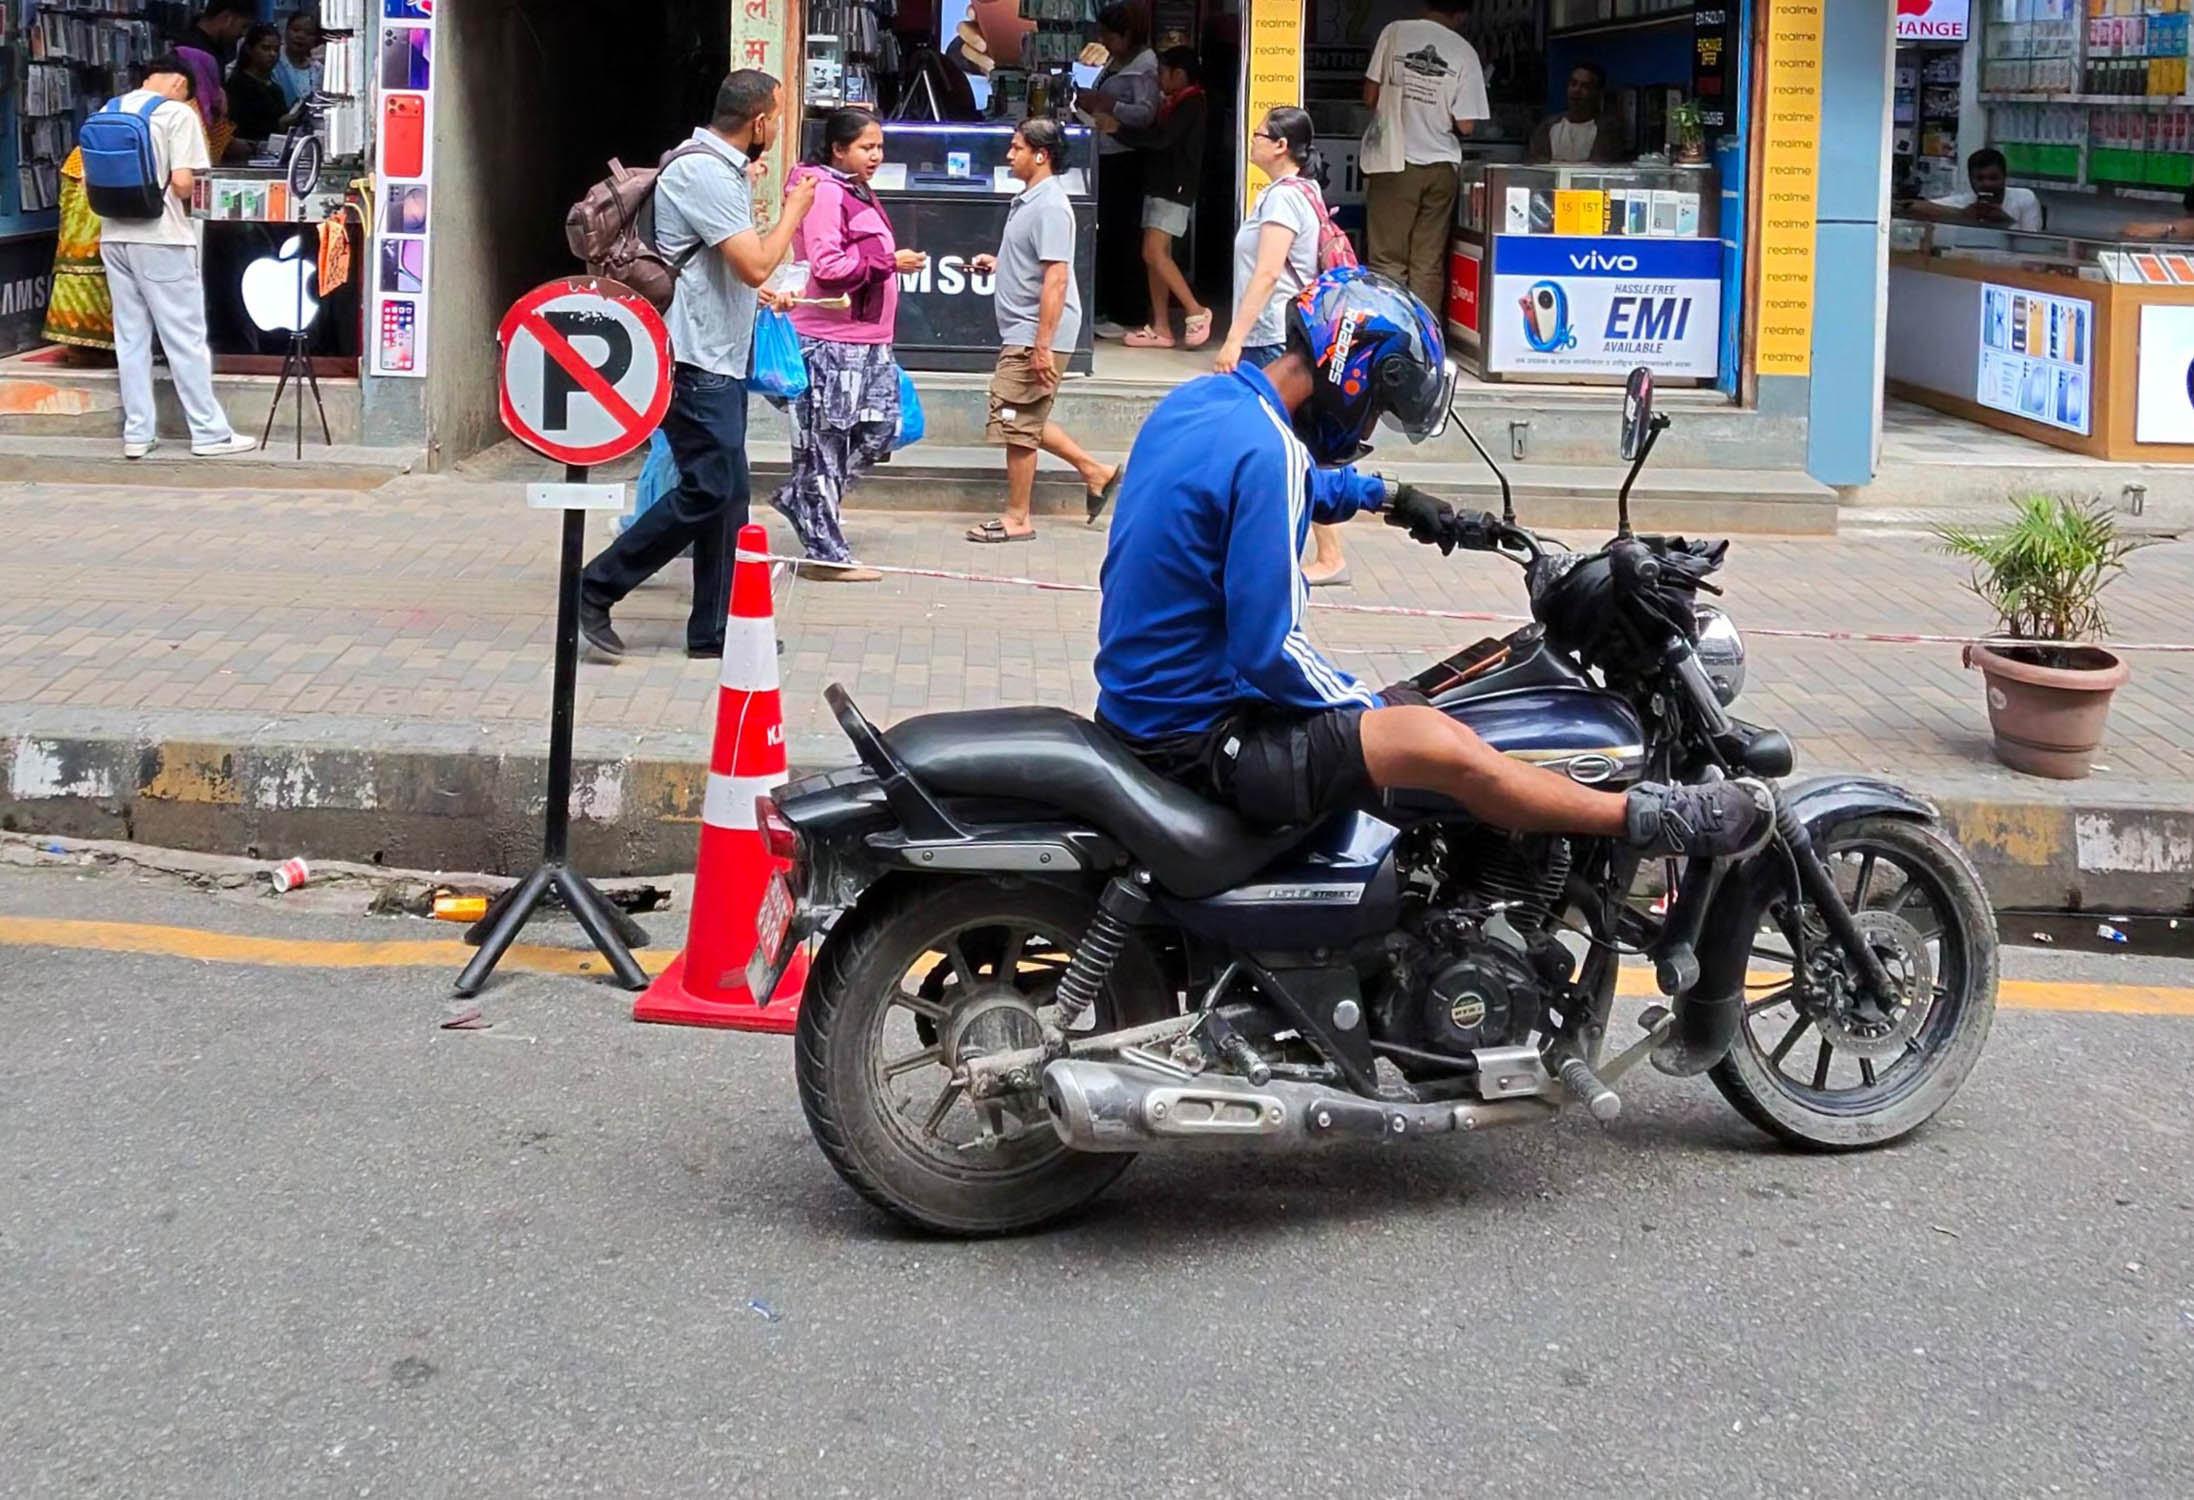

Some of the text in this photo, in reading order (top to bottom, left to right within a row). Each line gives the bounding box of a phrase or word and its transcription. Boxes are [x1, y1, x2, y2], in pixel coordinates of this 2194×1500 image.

[1777, 6, 1818, 15] realme
[1256, 19, 1297, 28] realme
[1775, 33, 1817, 41] realme
[1255, 47, 1296, 56] realme
[1774, 59, 1816, 68] realme
[1254, 73, 1295, 82] realme
[1774, 86, 1815, 95] realme
[1773, 112, 1814, 121] realme
[1771, 139, 1812, 148] realme
[1770, 166, 1811, 176] realme
[1769, 193, 1810, 202] realme
[1768, 220, 1810, 229] realme
[1767, 247, 1808, 256] realme
[1569, 250, 1638, 271] vivo
[1766, 273, 1808, 282] realme
[1614, 284, 1676, 295] HASSLE FREE
[1, 275, 52, 315] AMS
[1766, 299, 1807, 309] realme
[1604, 296, 1692, 341] EMI
[1764, 326, 1805, 335] realme
[1603, 342, 1664, 354] AVAILABLE
[1763, 352, 1804, 362] realme
[542, 311, 633, 431] P
